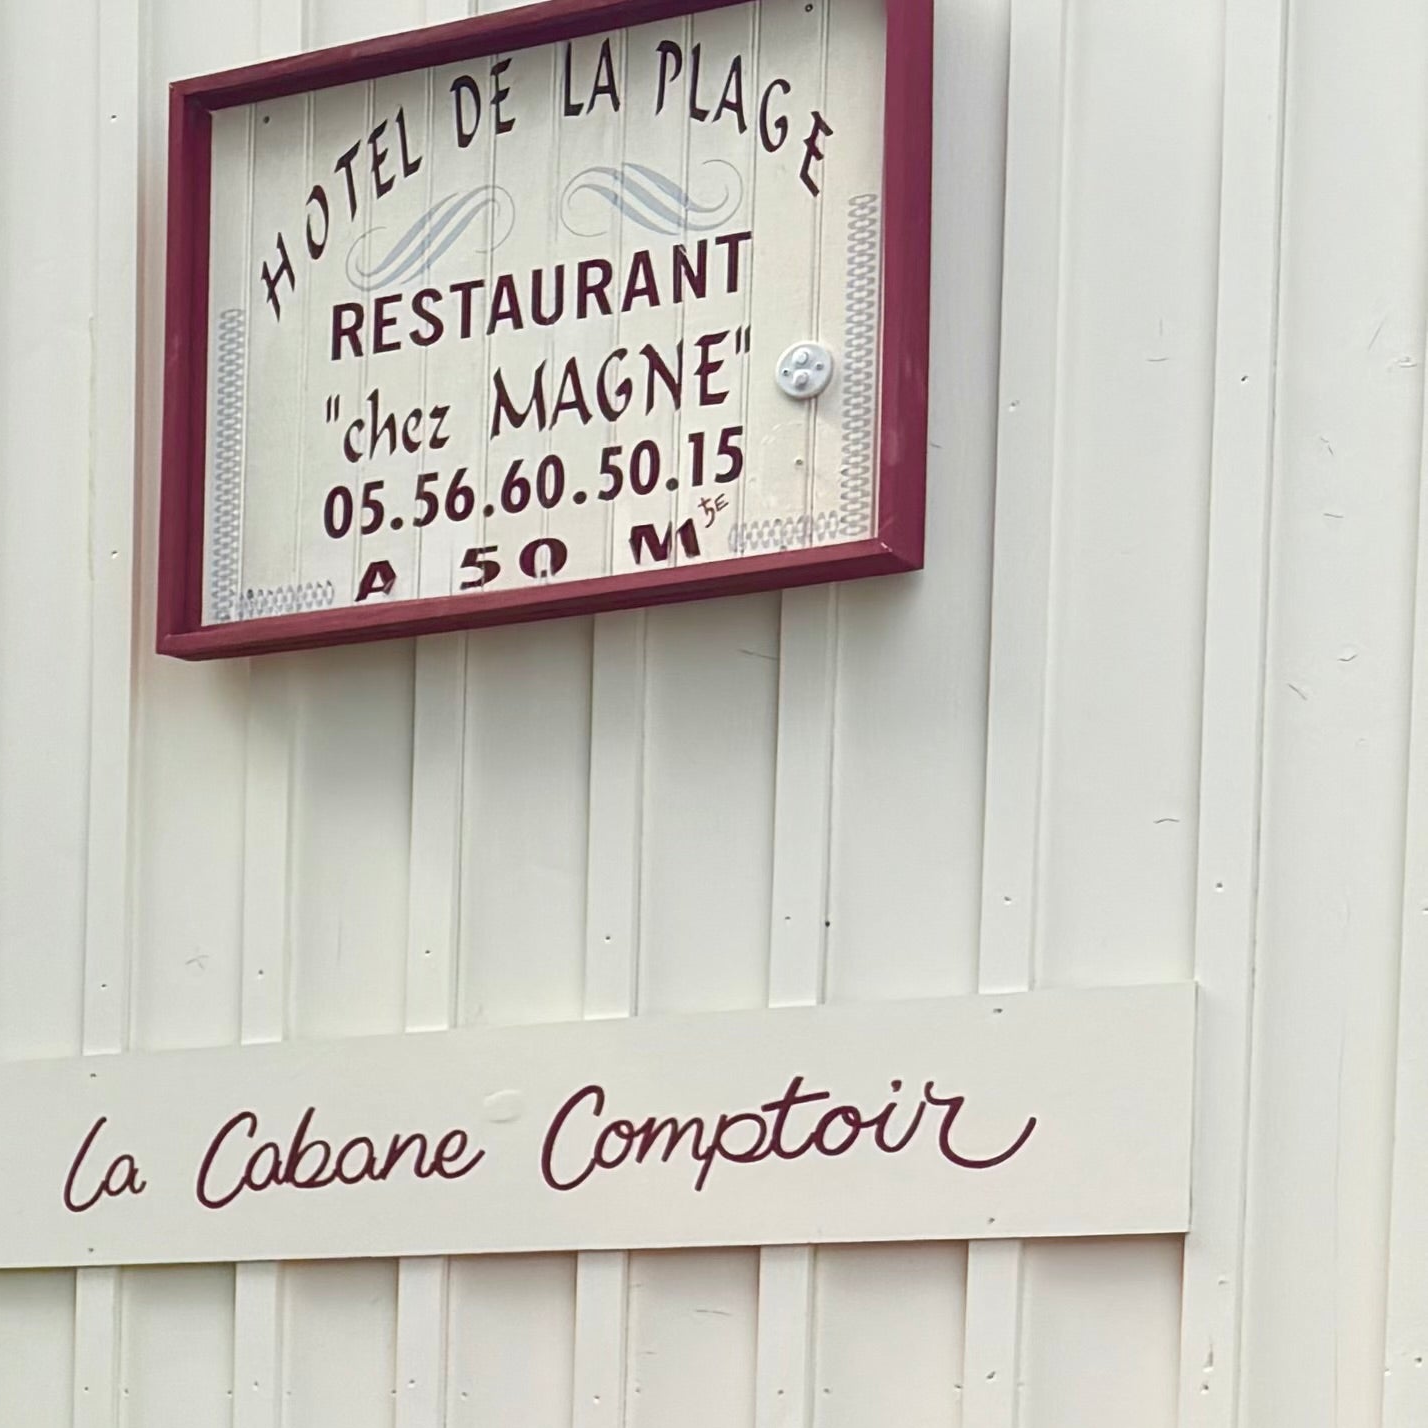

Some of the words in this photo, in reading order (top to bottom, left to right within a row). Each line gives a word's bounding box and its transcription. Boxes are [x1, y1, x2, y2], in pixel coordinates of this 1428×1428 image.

[260, 106, 423, 321] HOTEL
[449, 57, 518, 149] DE
[561, 37, 622, 118] LA
[655, 39, 835, 197] PLAGE
[330, 231, 752, 361] RESTAURANT
[326, 388, 451, 463] "chez
[489, 325, 752, 440] MAGNE"
[323, 425, 745, 539] 05.56.60.50.15
[354, 559, 397, 603] A
[459, 536, 568, 591] 50
[628, 516, 702, 566] M
[63, 1115, 148, 1214] La
[195, 1106, 487, 1211] Cabane
[540, 1075, 1039, 1193] Comptoir
